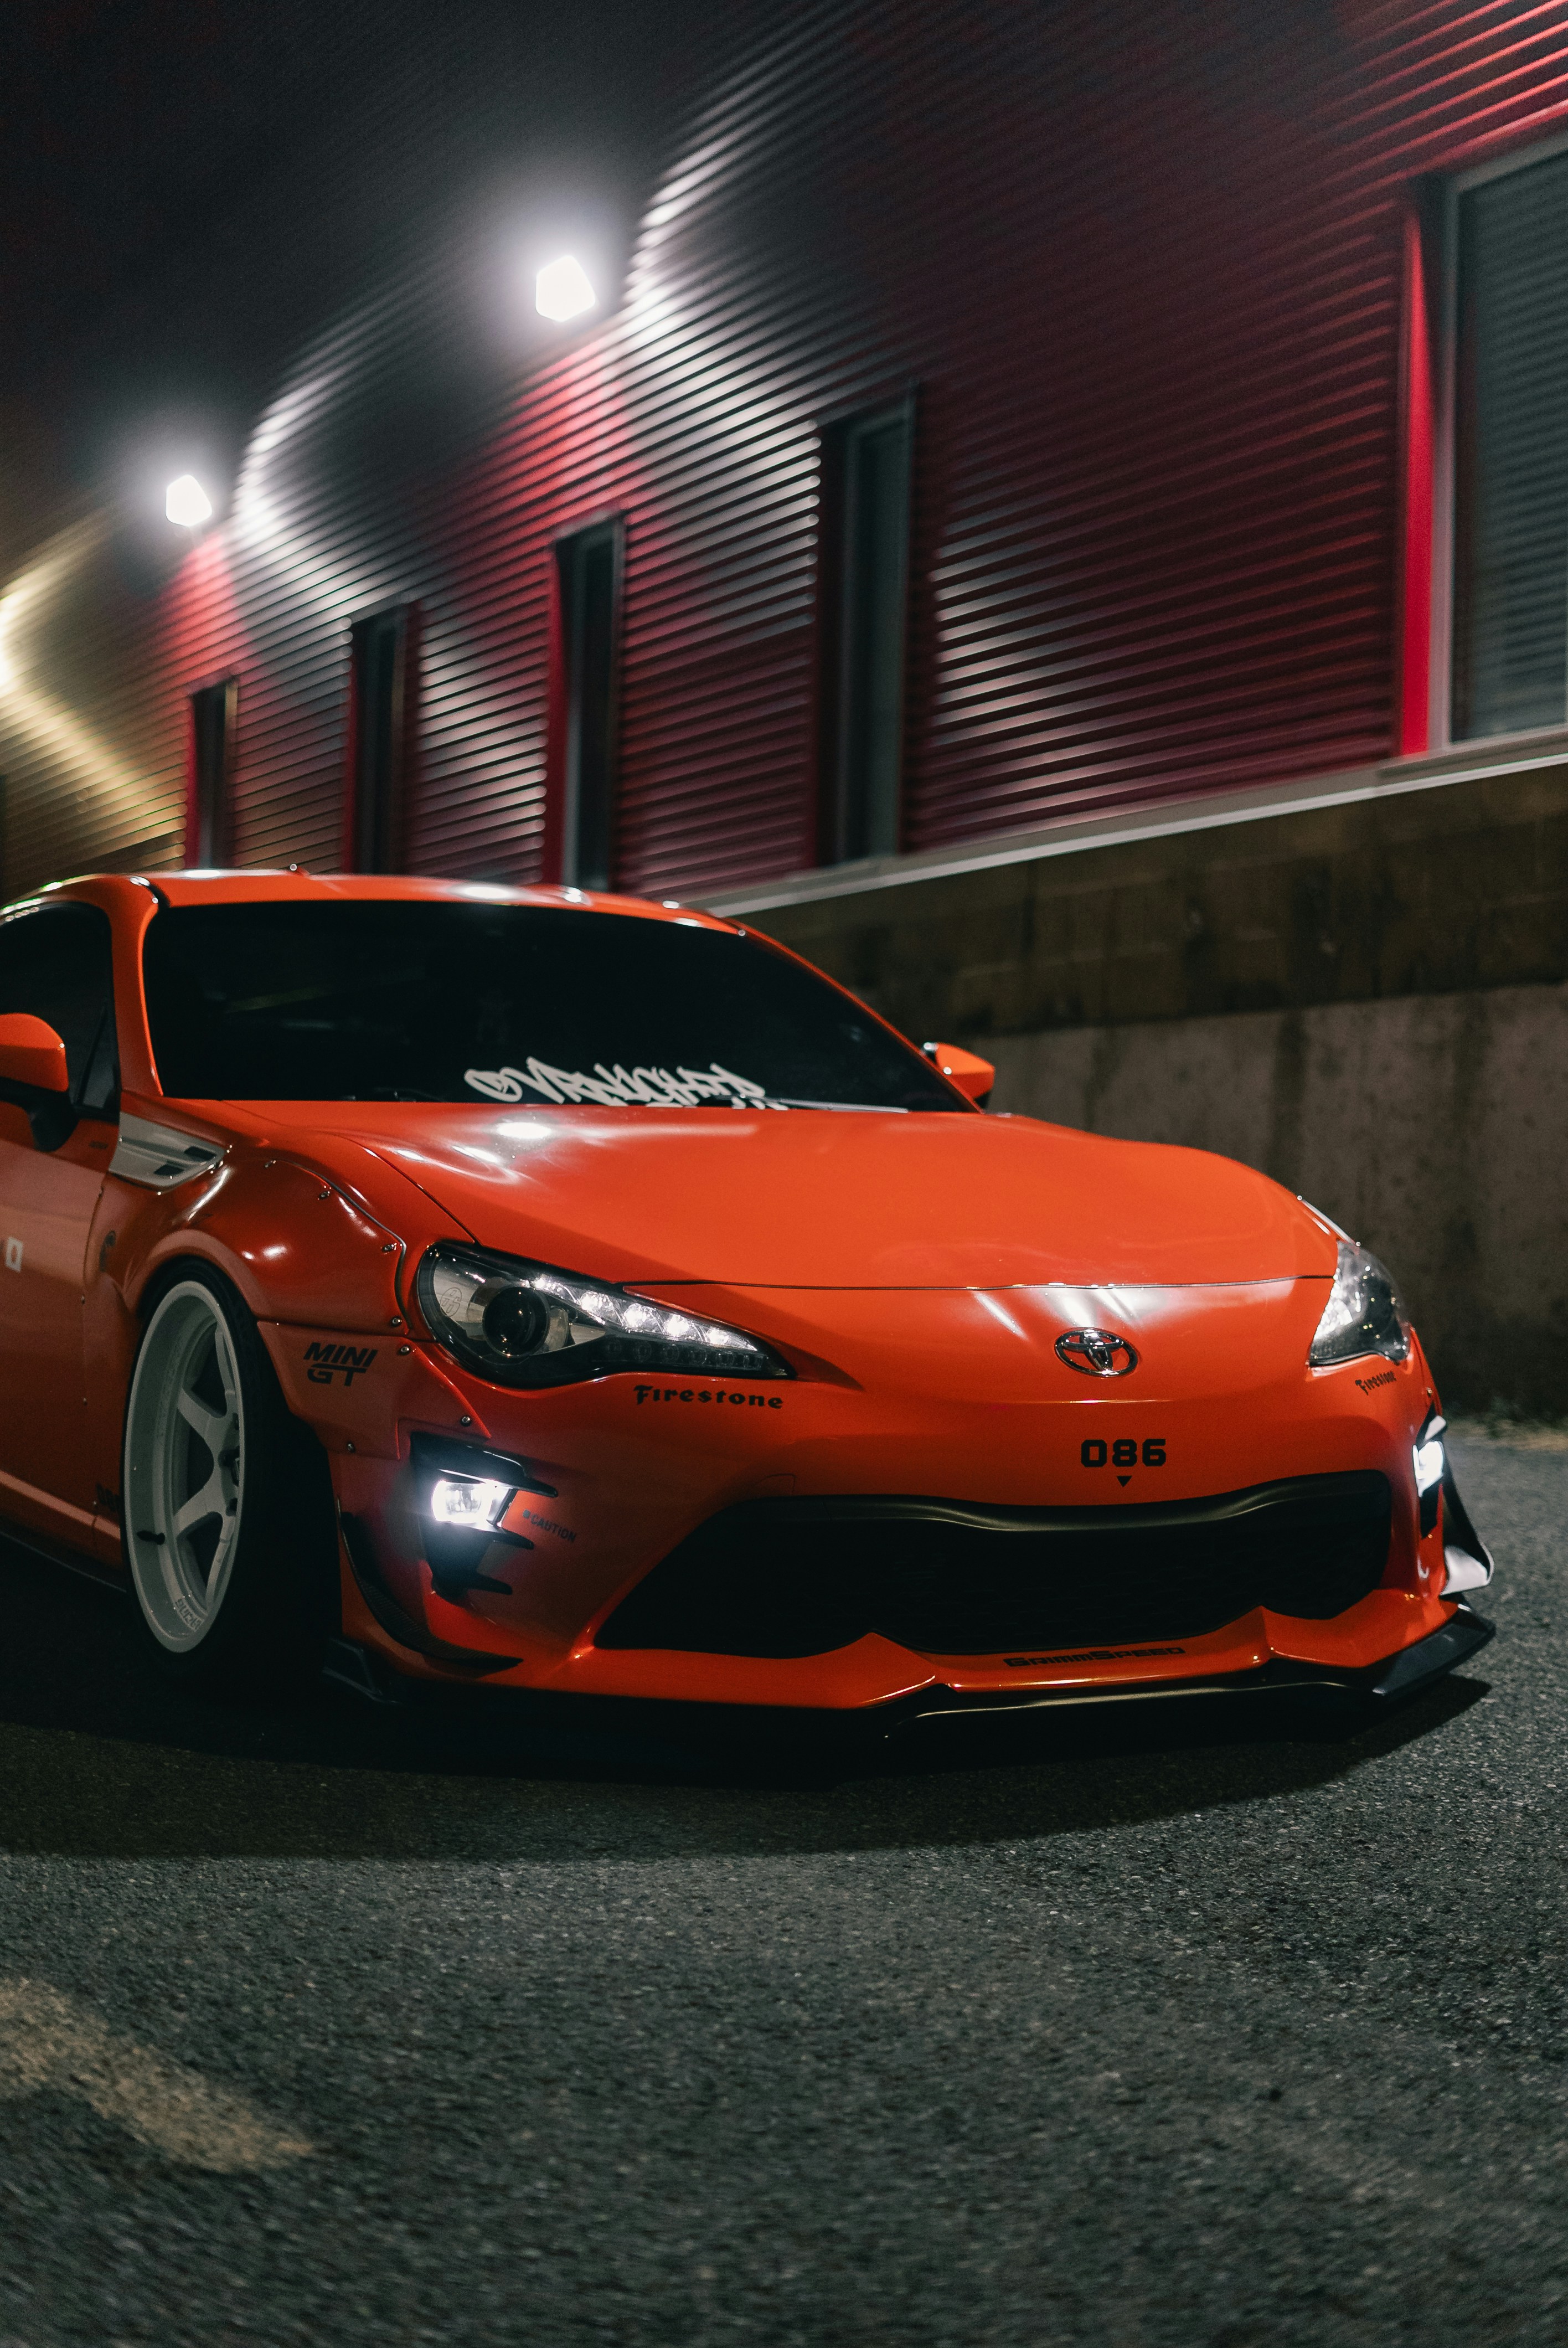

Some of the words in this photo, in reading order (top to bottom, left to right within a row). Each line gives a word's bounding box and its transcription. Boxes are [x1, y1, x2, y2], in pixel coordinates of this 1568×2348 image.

[303, 1342, 378, 1367] MINI
[307, 1363, 367, 1386] GT
[633, 1384, 783, 1409] Firestone
[1081, 1439, 1166, 1468] 086
